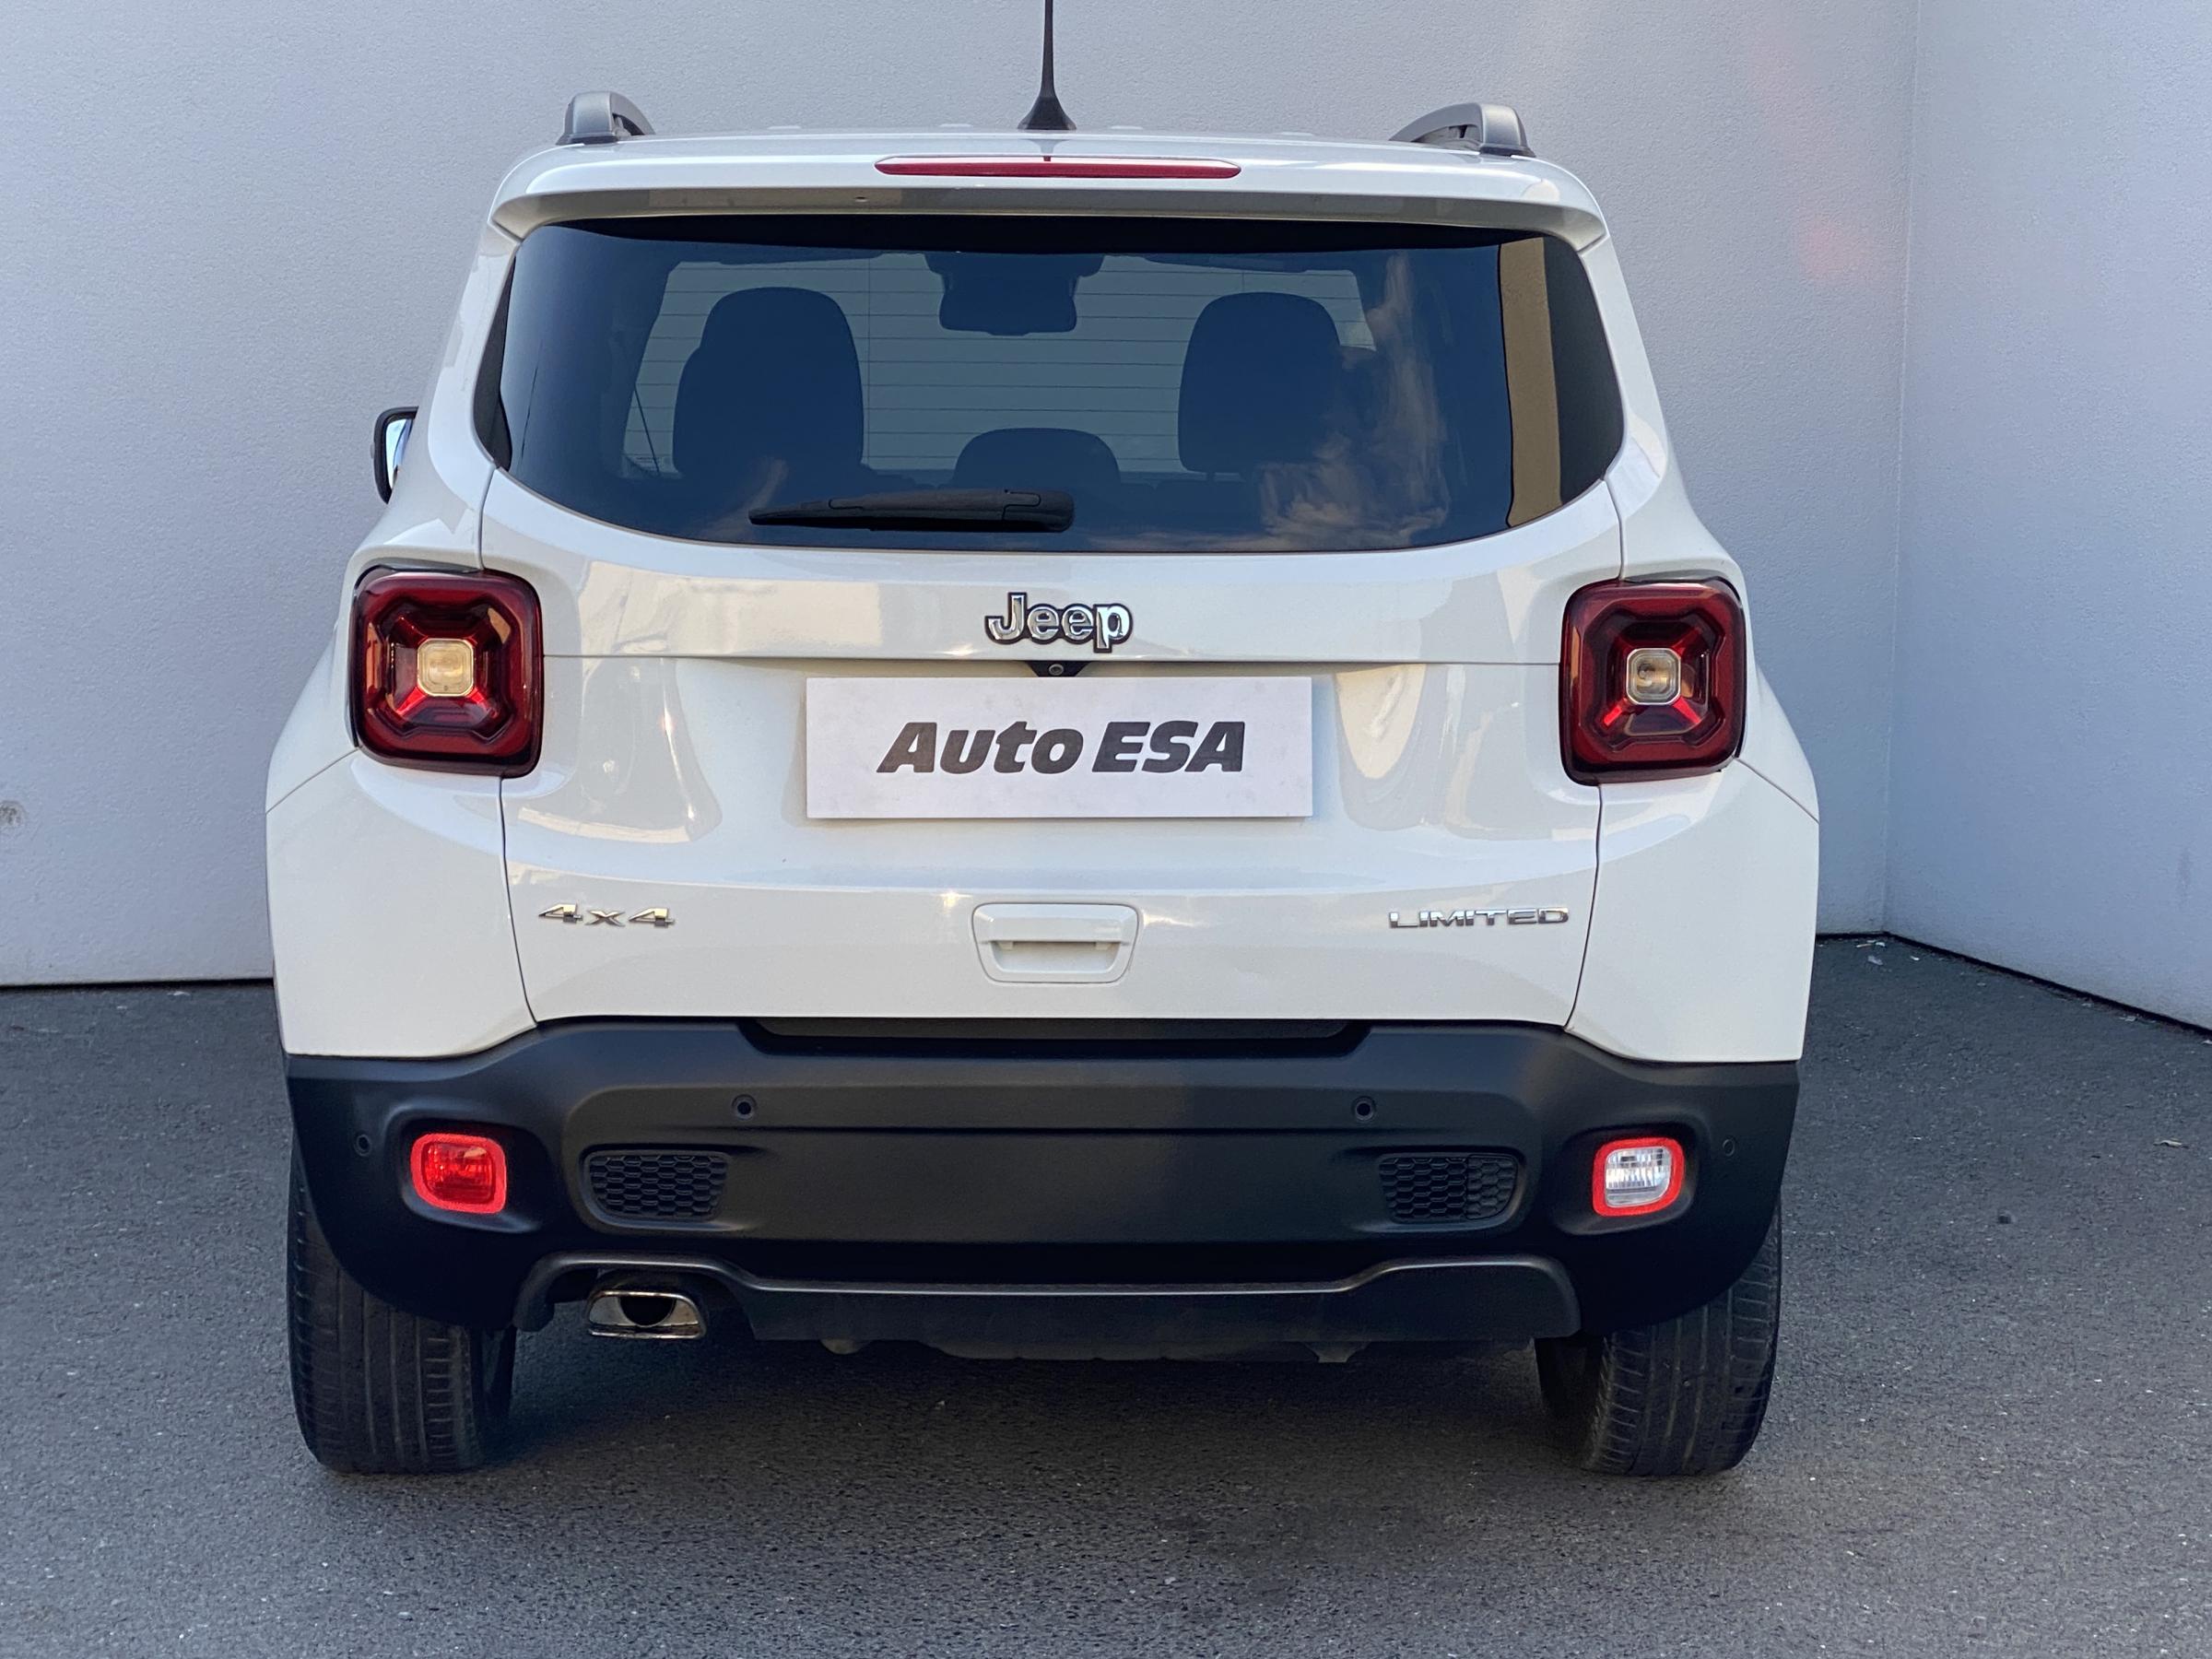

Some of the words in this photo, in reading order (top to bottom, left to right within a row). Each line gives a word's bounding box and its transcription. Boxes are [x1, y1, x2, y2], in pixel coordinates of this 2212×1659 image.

[985, 592, 1133, 653] Jeep
[877, 721, 1084, 774] Auto
[1092, 720, 1245, 773] ESA
[538, 903, 676, 928] 4x4
[1389, 907, 1569, 928] LIMITED
